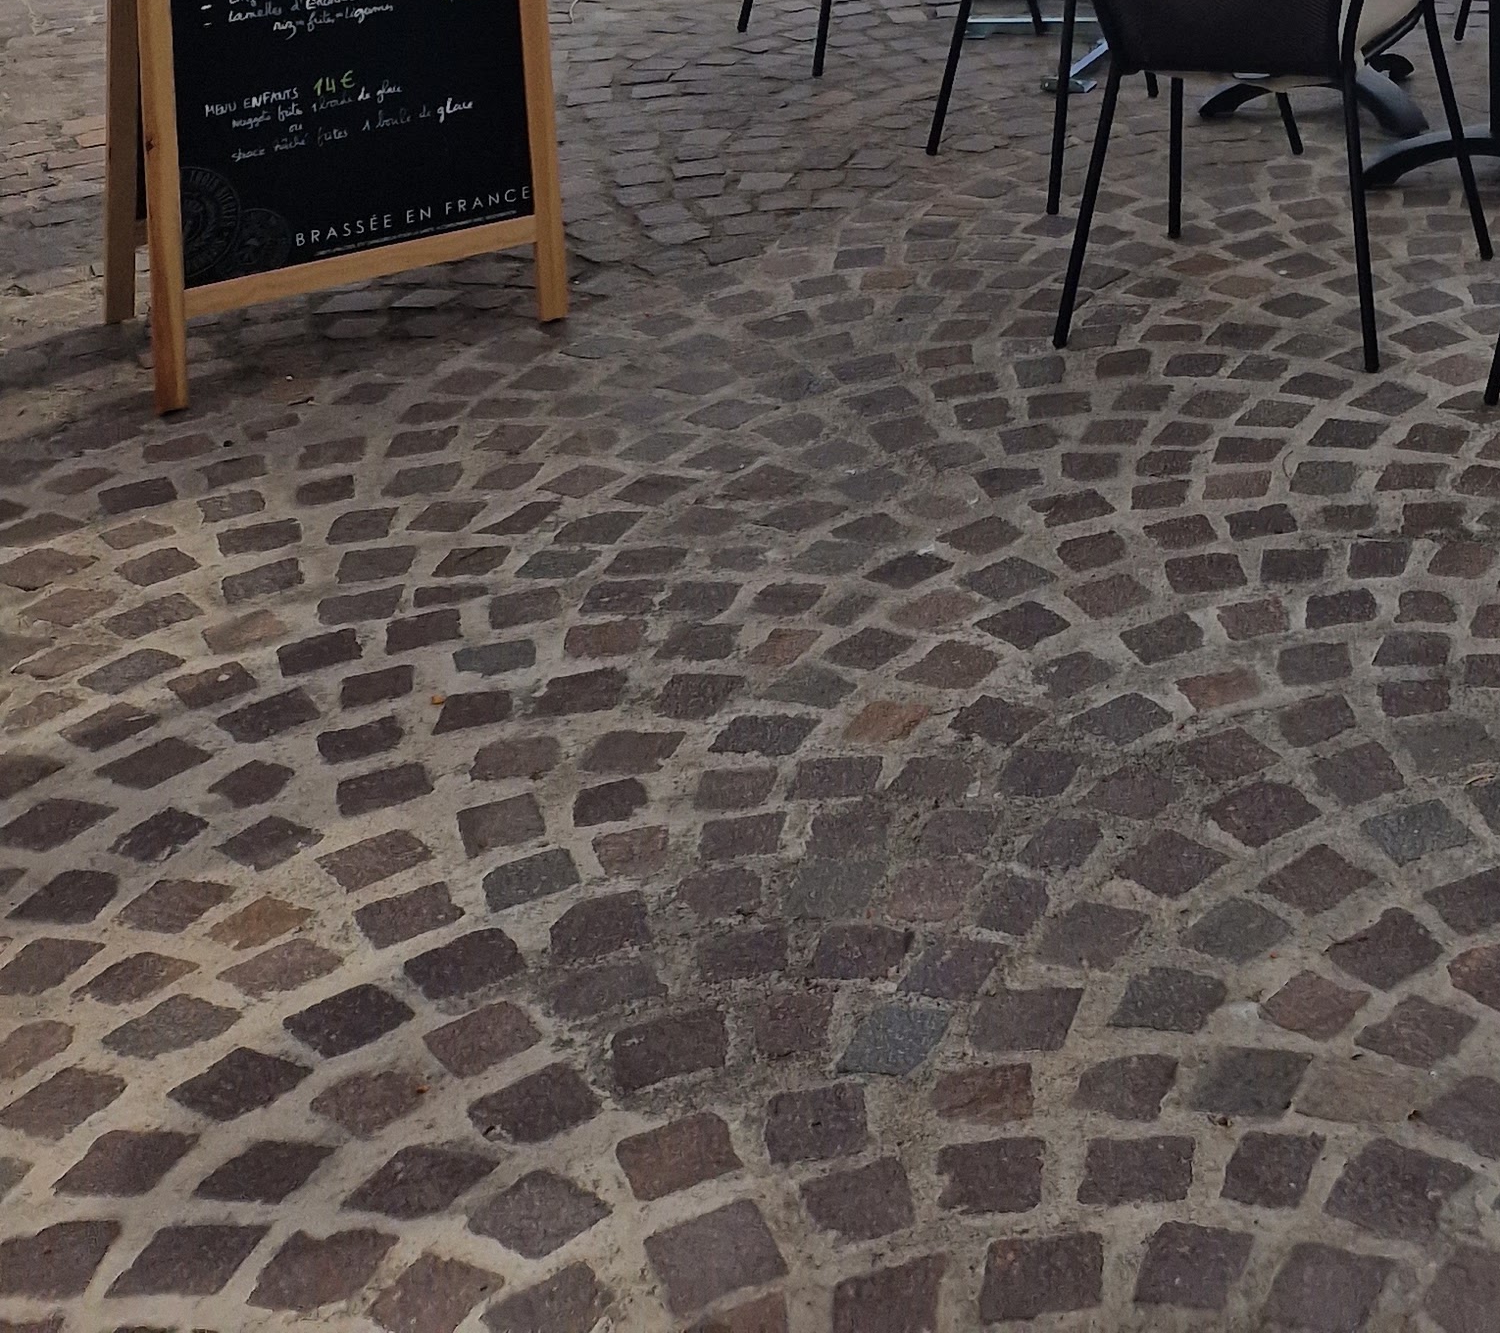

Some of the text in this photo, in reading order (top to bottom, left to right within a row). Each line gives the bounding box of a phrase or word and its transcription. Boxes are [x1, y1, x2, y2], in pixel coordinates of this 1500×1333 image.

[205, 102, 237, 117] MENU
[296, 214, 394, 247] BRASSÉE
[406, 206, 432, 224] EN
[445, 185, 532, 216] FRANCE
